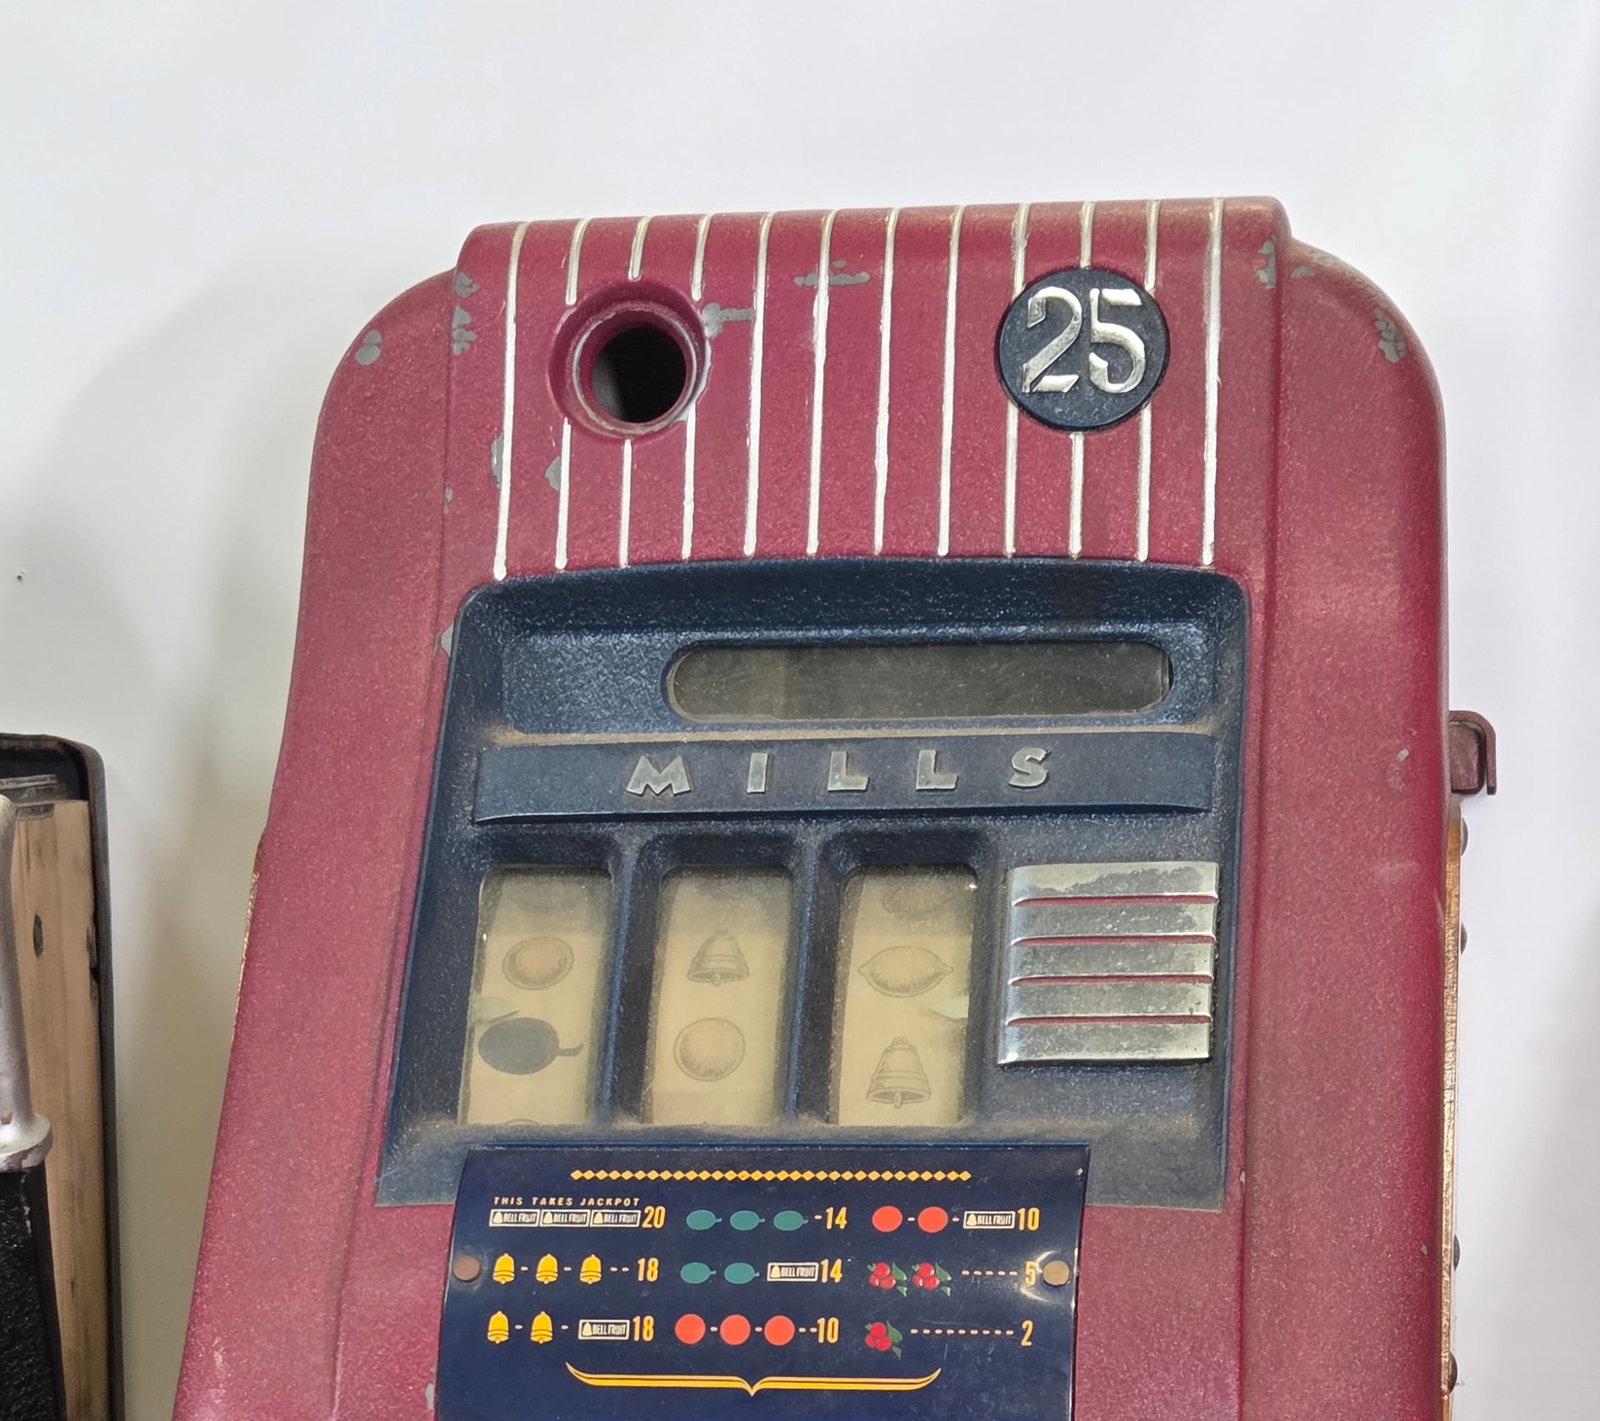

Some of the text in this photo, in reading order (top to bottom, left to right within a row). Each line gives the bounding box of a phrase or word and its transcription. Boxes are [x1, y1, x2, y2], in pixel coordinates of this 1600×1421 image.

[1022, 286, 1146, 393] 25
[626, 746, 1050, 797] MILLS
[493, 1196, 640, 1207] THIS TAKES JACKPOT
[503, 1206, 666, 1229] BELL FRUIT BELL FRUIT BELL FRUIT 20
[825, 1206, 848, 1230] 14
[977, 1207, 1040, 1231] BELL FRUIT 10
[638, 1257, 659, 1282] 18
[780, 1258, 843, 1283] BELL FRUIT 14
[1024, 1260, 1038, 1287] 5
[592, 1315, 654, 1342] BELL FRUIT 18
[817, 1317, 840, 1344] 10
[1020, 1319, 1034, 1347] 2
